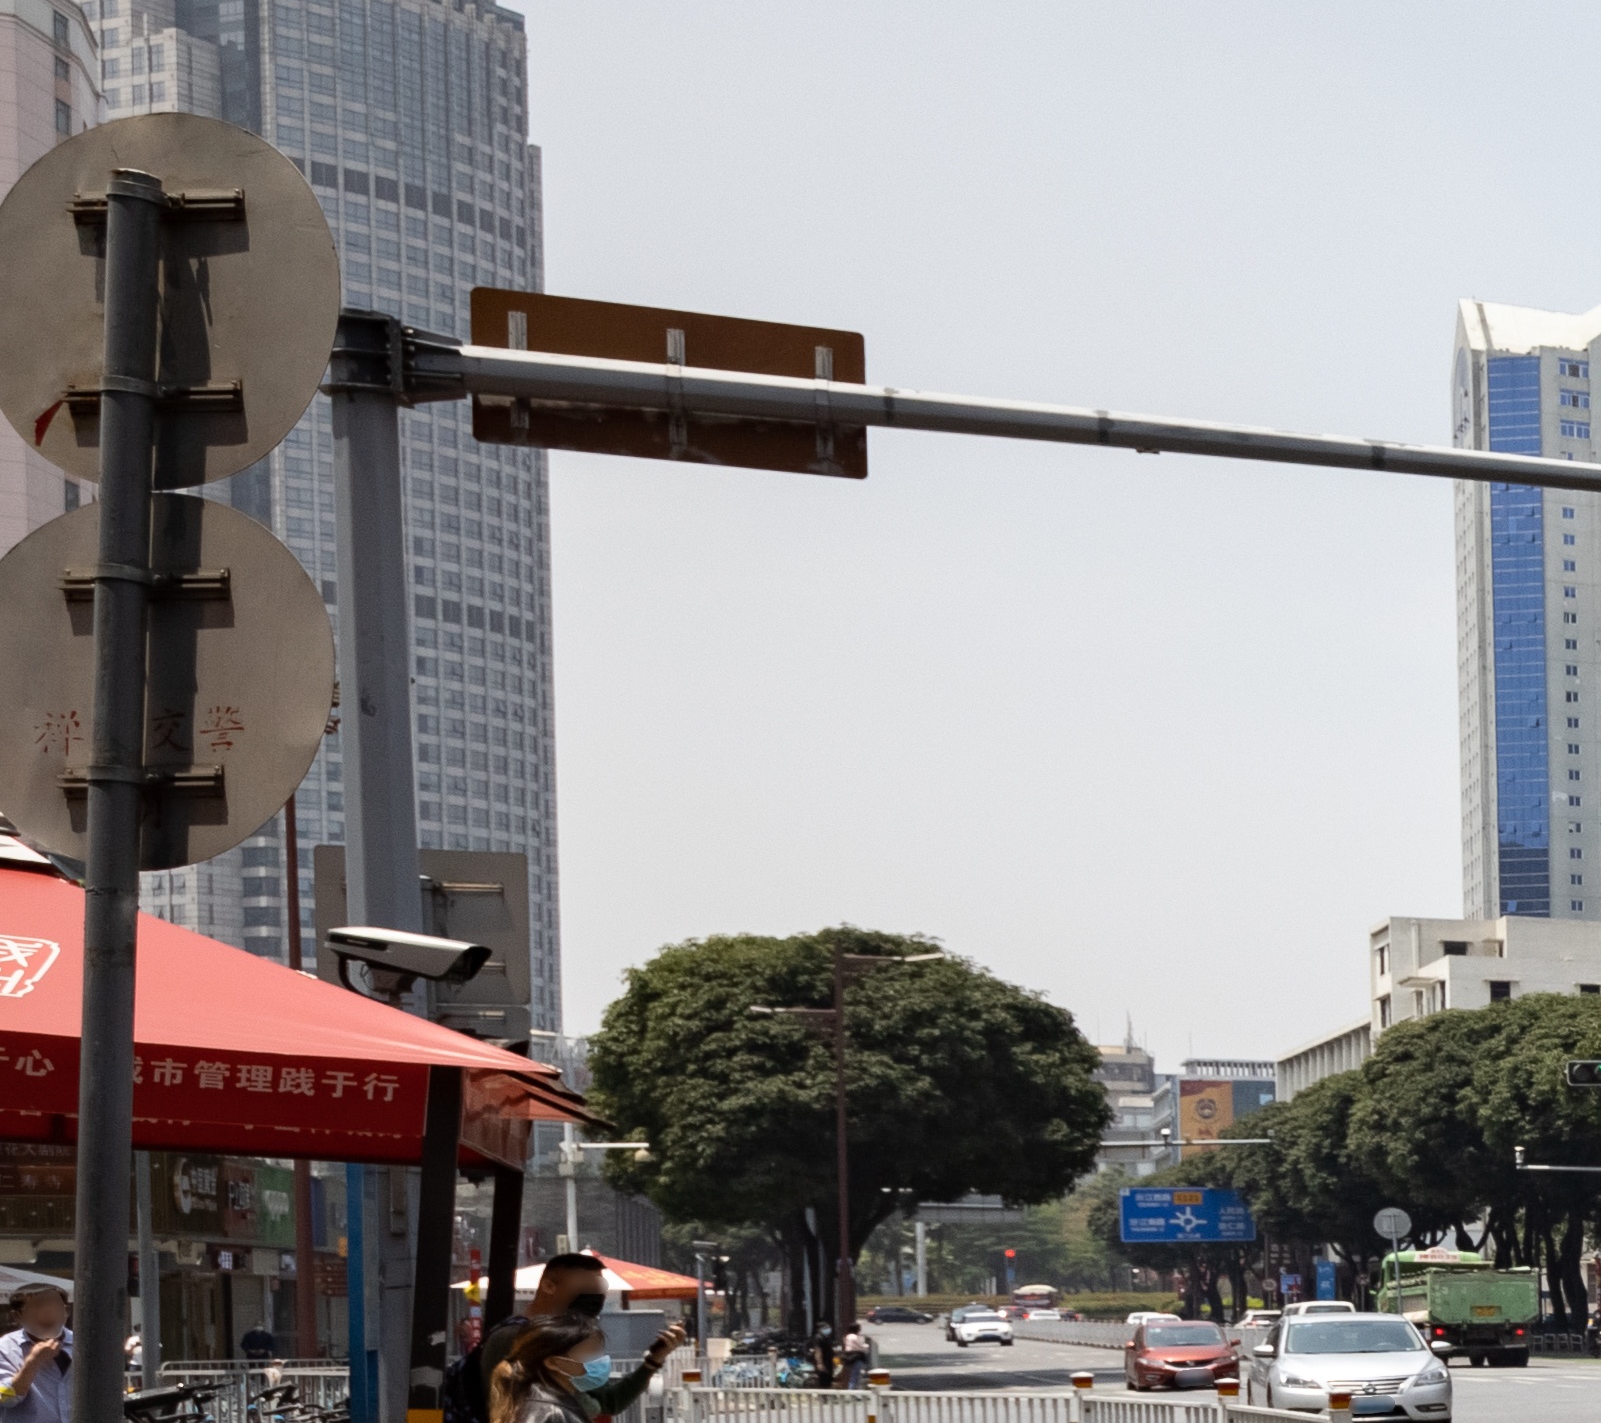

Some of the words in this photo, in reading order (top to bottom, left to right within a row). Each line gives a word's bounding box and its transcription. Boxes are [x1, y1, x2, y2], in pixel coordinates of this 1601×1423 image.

[34, 705, 246, 756] 禅交警
[0, 1047, 55, 1078] 心
